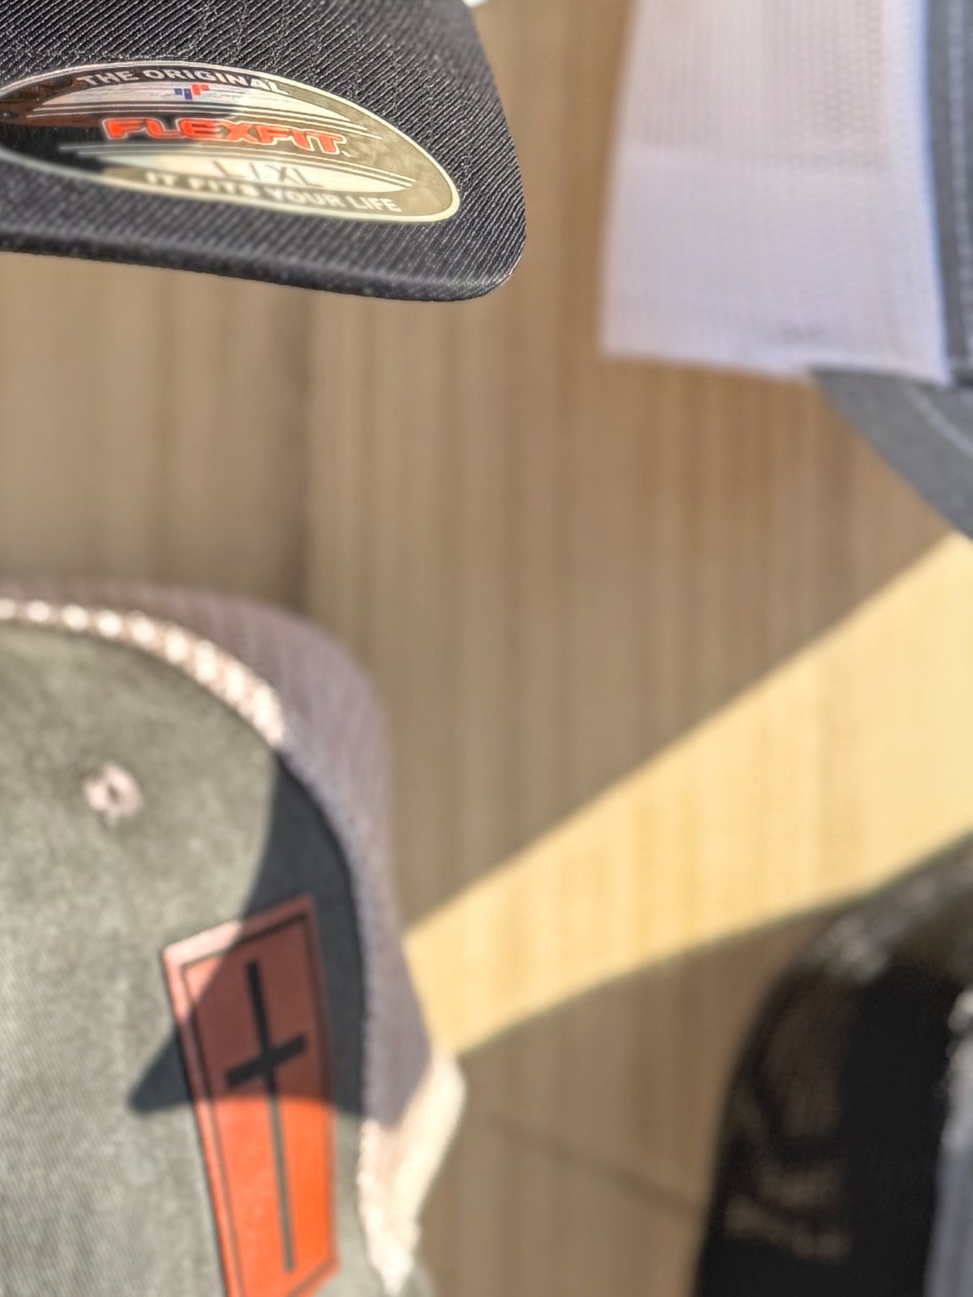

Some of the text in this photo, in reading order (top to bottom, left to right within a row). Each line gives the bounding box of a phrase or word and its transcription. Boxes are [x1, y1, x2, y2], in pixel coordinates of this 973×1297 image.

[77, 68, 292, 94] THE ORIGINAL
[101, 117, 347, 155] FLEXFIT
[145, 170, 403, 213] IT FITS YOUR LIFE
